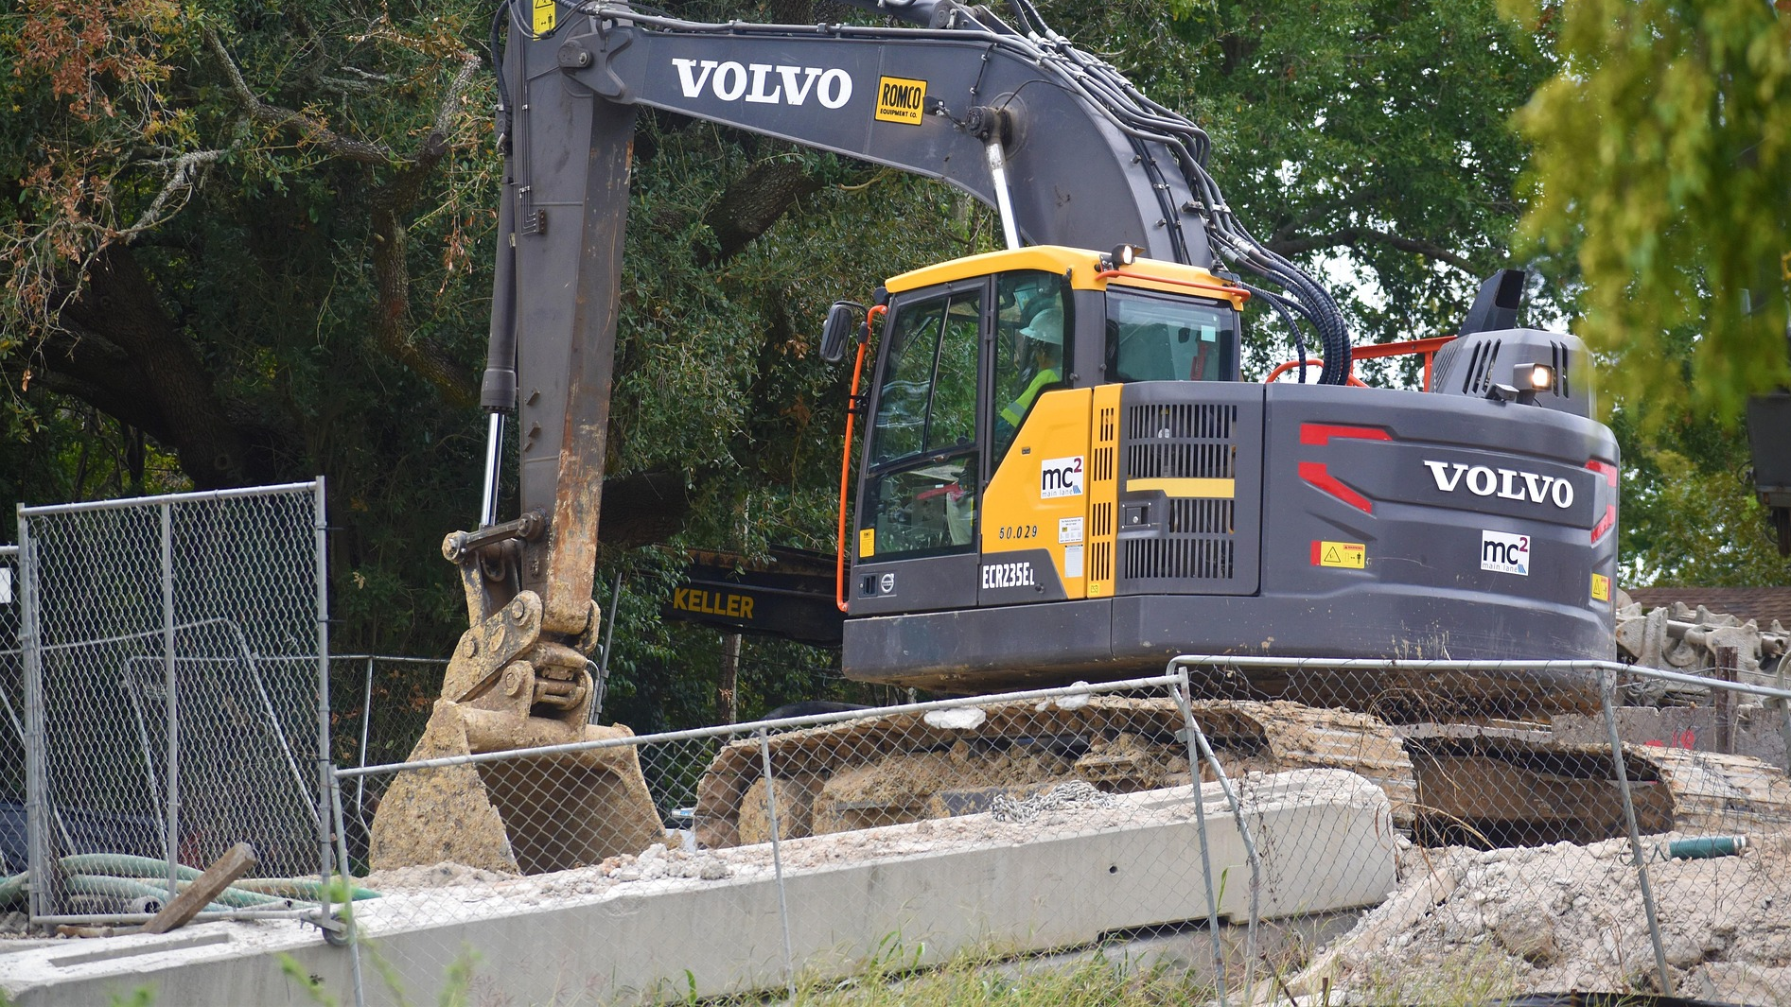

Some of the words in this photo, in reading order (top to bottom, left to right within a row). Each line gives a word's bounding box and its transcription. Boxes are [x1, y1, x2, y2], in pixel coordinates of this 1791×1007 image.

[672, 58, 853, 109] VOLVO
[882, 83, 921, 110] ROMCO
[880, 108, 908, 117] EQUIPMENT
[1042, 490, 1058, 498] main
[1423, 459, 1575, 509] VOLVO
[1482, 562, 1501, 571] main
[1502, 564, 1518, 573] lane
[673, 587, 754, 620] KELLER
